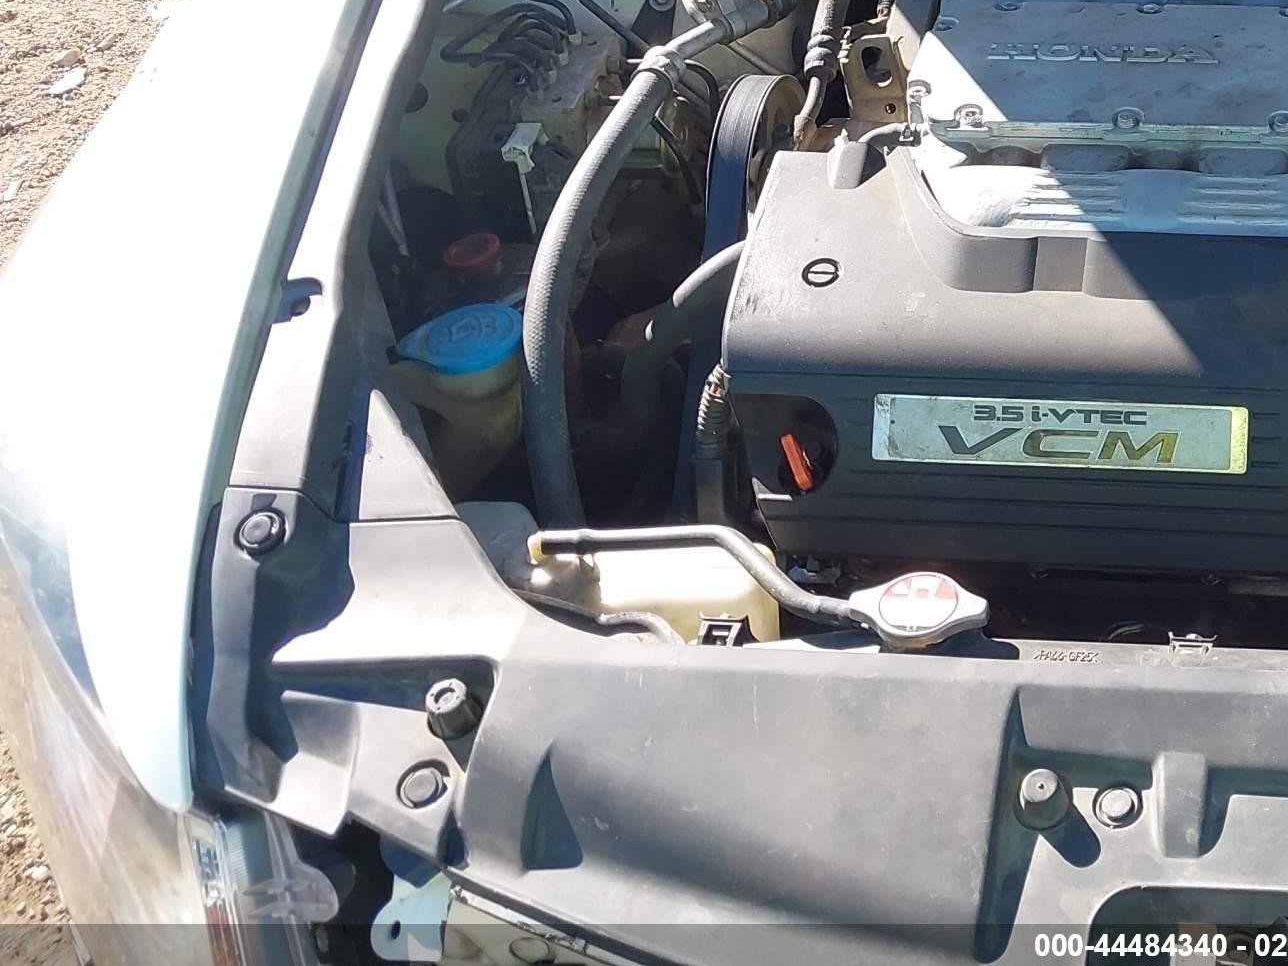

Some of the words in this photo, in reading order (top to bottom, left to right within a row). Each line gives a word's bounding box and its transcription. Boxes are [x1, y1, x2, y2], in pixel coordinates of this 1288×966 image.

[987, 42, 1219, 64] HONDA
[973, 404, 1025, 422] 3.5
[1031, 405, 1148, 426] i-VTEC
[938, 425, 1180, 464] VCM
